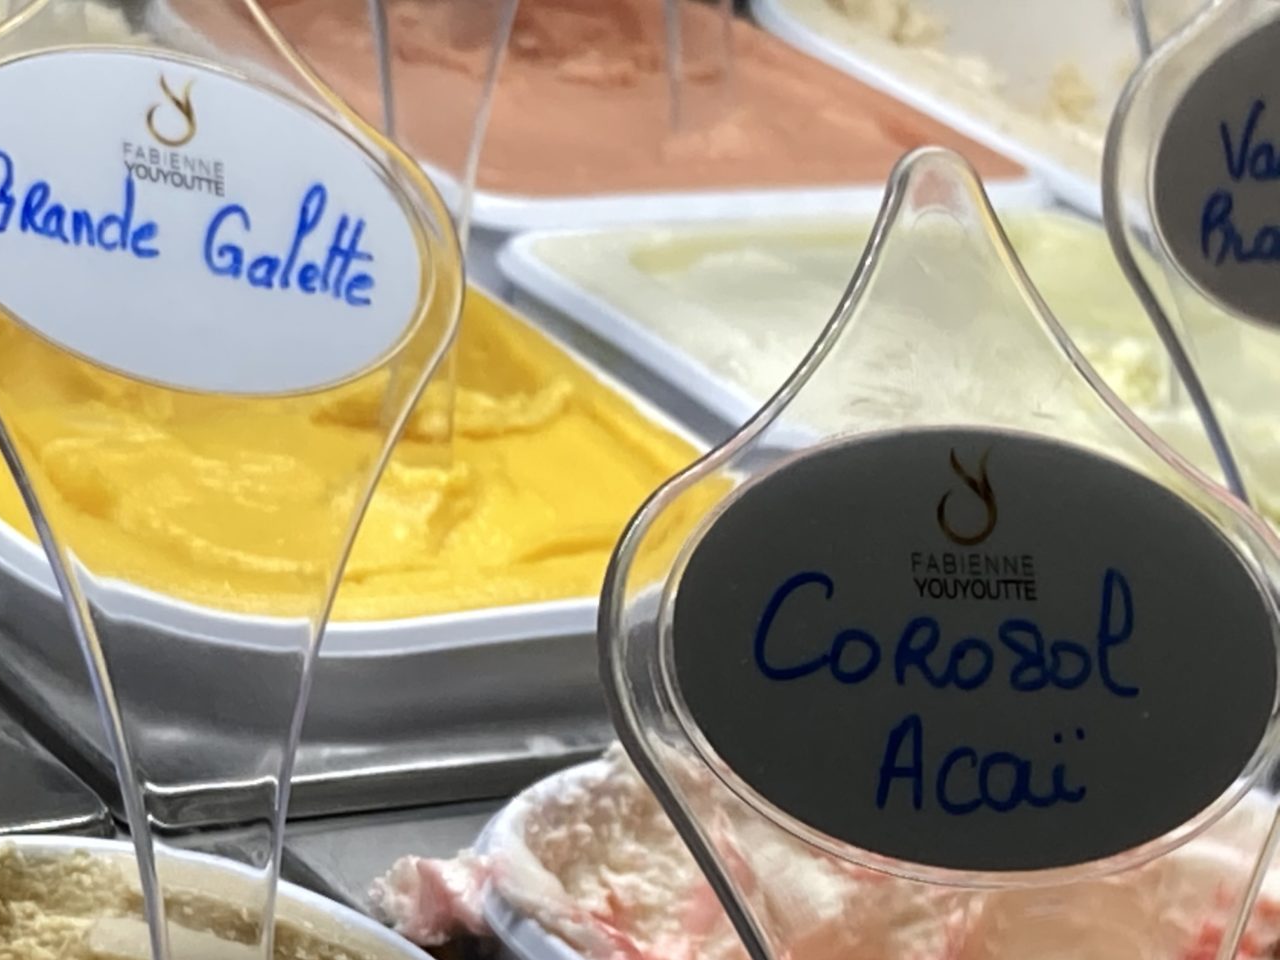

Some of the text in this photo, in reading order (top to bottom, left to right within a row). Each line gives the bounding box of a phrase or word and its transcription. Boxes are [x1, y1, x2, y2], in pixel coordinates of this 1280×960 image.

[1220, 99, 1280, 182] Va
[122, 141, 225, 181] FABIENNE
[123, 160, 225, 197] YOUYOUTTE
[204, 182, 375, 307] Galette
[911, 552, 1034, 576] FABIENNE
[913, 578, 1038, 602] YOUYOUTTE
[875, 713, 1087, 815] Acaï
